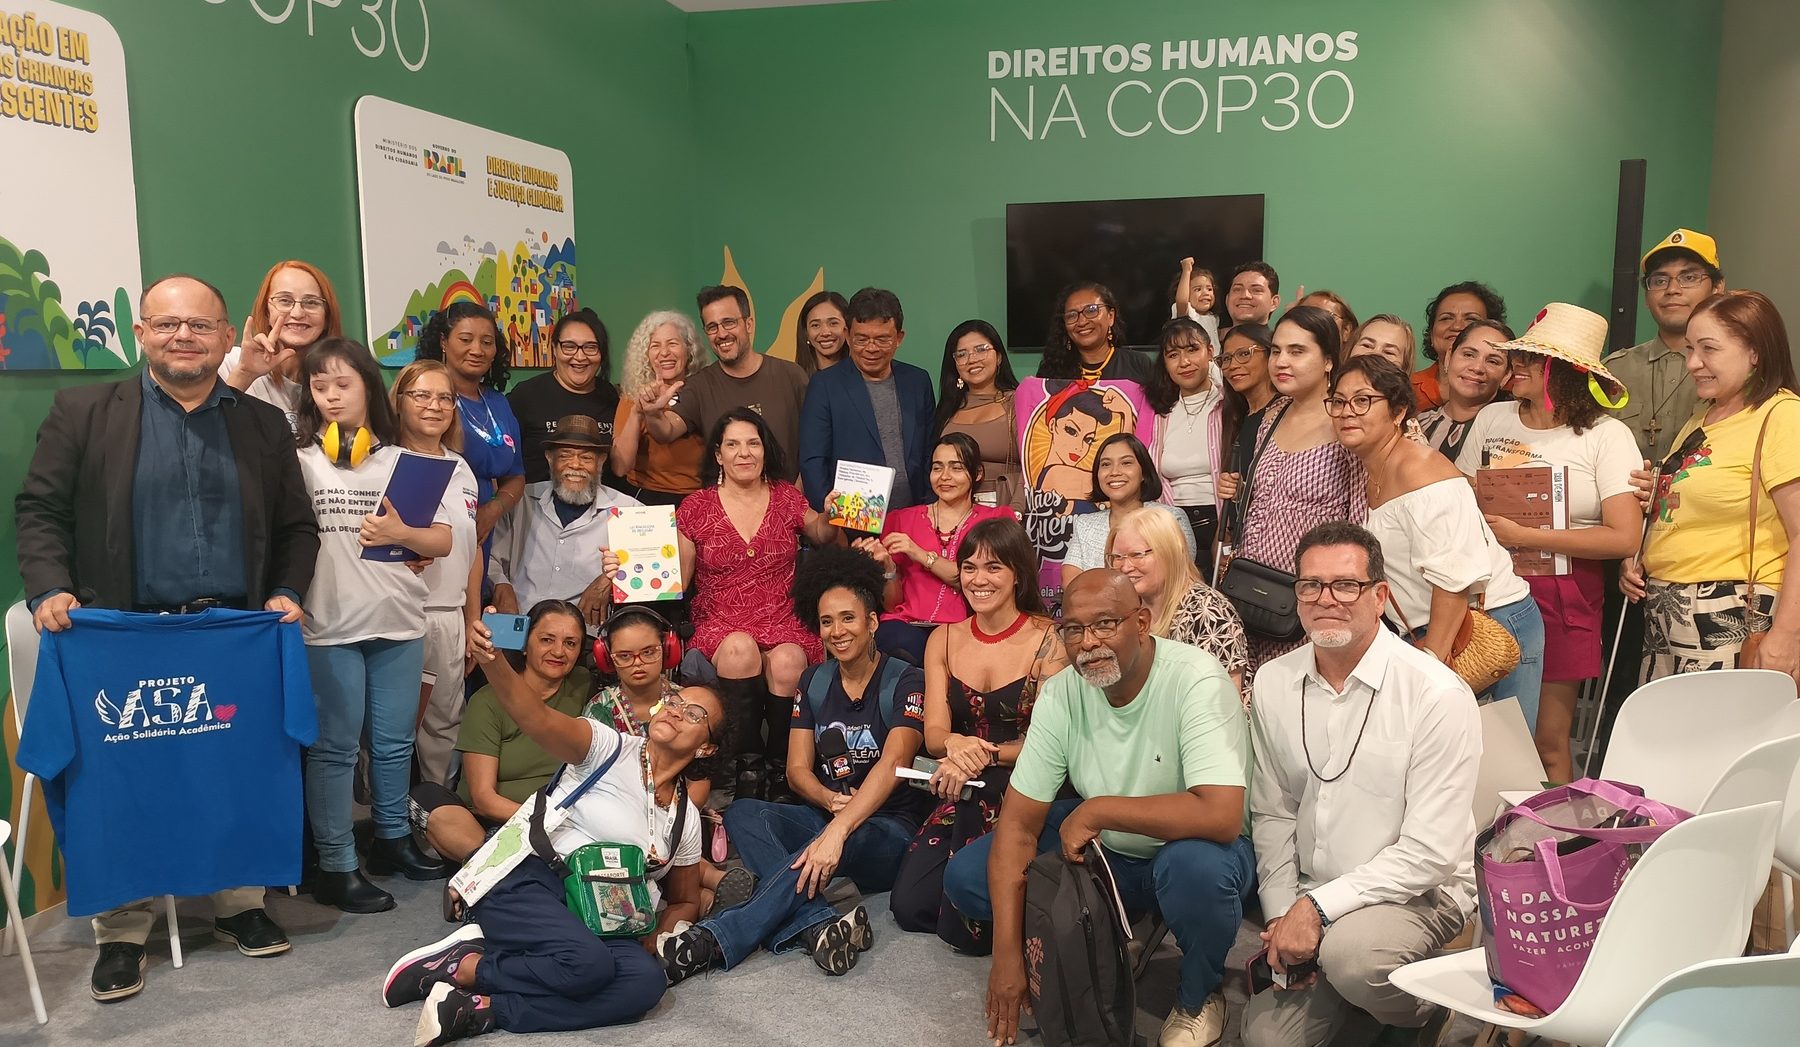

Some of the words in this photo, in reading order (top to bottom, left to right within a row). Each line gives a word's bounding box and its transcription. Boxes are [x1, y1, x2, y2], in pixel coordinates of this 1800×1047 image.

[57, 27, 90, 66] EM
[988, 43, 1152, 79] DIREITOS
[1162, 31, 1359, 71] HUMANOS
[17, 57, 94, 97] CRIANÇAS
[0, 81, 99, 134] SCENTES
[990, 83, 1087, 142] NA
[1106, 70, 1355, 137] COP30
[375, 143, 396, 154] DIREITOS
[396, 149, 418, 159] HUMANOS
[432, 143, 450, 153] GOVERNO
[395, 157, 419, 167] CIDADANIA
[423, 148, 466, 179] BRASIL
[487, 155, 521, 182] DIREITOS
[522, 165, 559, 192] HUMANOS
[487, 178, 493, 197] E
[494, 180, 526, 208] JUSTIÇA
[527, 187, 564, 213] CLIMÁTICA
[314, 489, 325, 497] SE
[328, 488, 345, 496] NÃO
[315, 498, 326, 506] SE
[328, 497, 346, 505] NÃO
[348, 499, 378, 507] ENTEN
[1024, 489, 1063, 511] Mães
[318, 508, 328, 516] SE
[319, 525, 337, 534] NÃO
[1023, 508, 1073, 559] Guer
[1040, 585, 1055, 597] ela
[139, 676, 195, 688] PROJETO
[118, 683, 213, 729] ASA
[904, 704, 924, 716] VIST
[103, 733, 130, 743] Ação
[133, 728, 176, 739] Solidária
[178, 722, 231, 735] Acadêmica
[848, 747, 880, 760] ELÉM
[1612, 859, 1627, 888] IMPACTO
[1501, 888, 1511, 904] É
[1521, 891, 1552, 905] DA
[1506, 905, 1578, 924] NOSSA
[1513, 943, 1547, 956] FAZER
